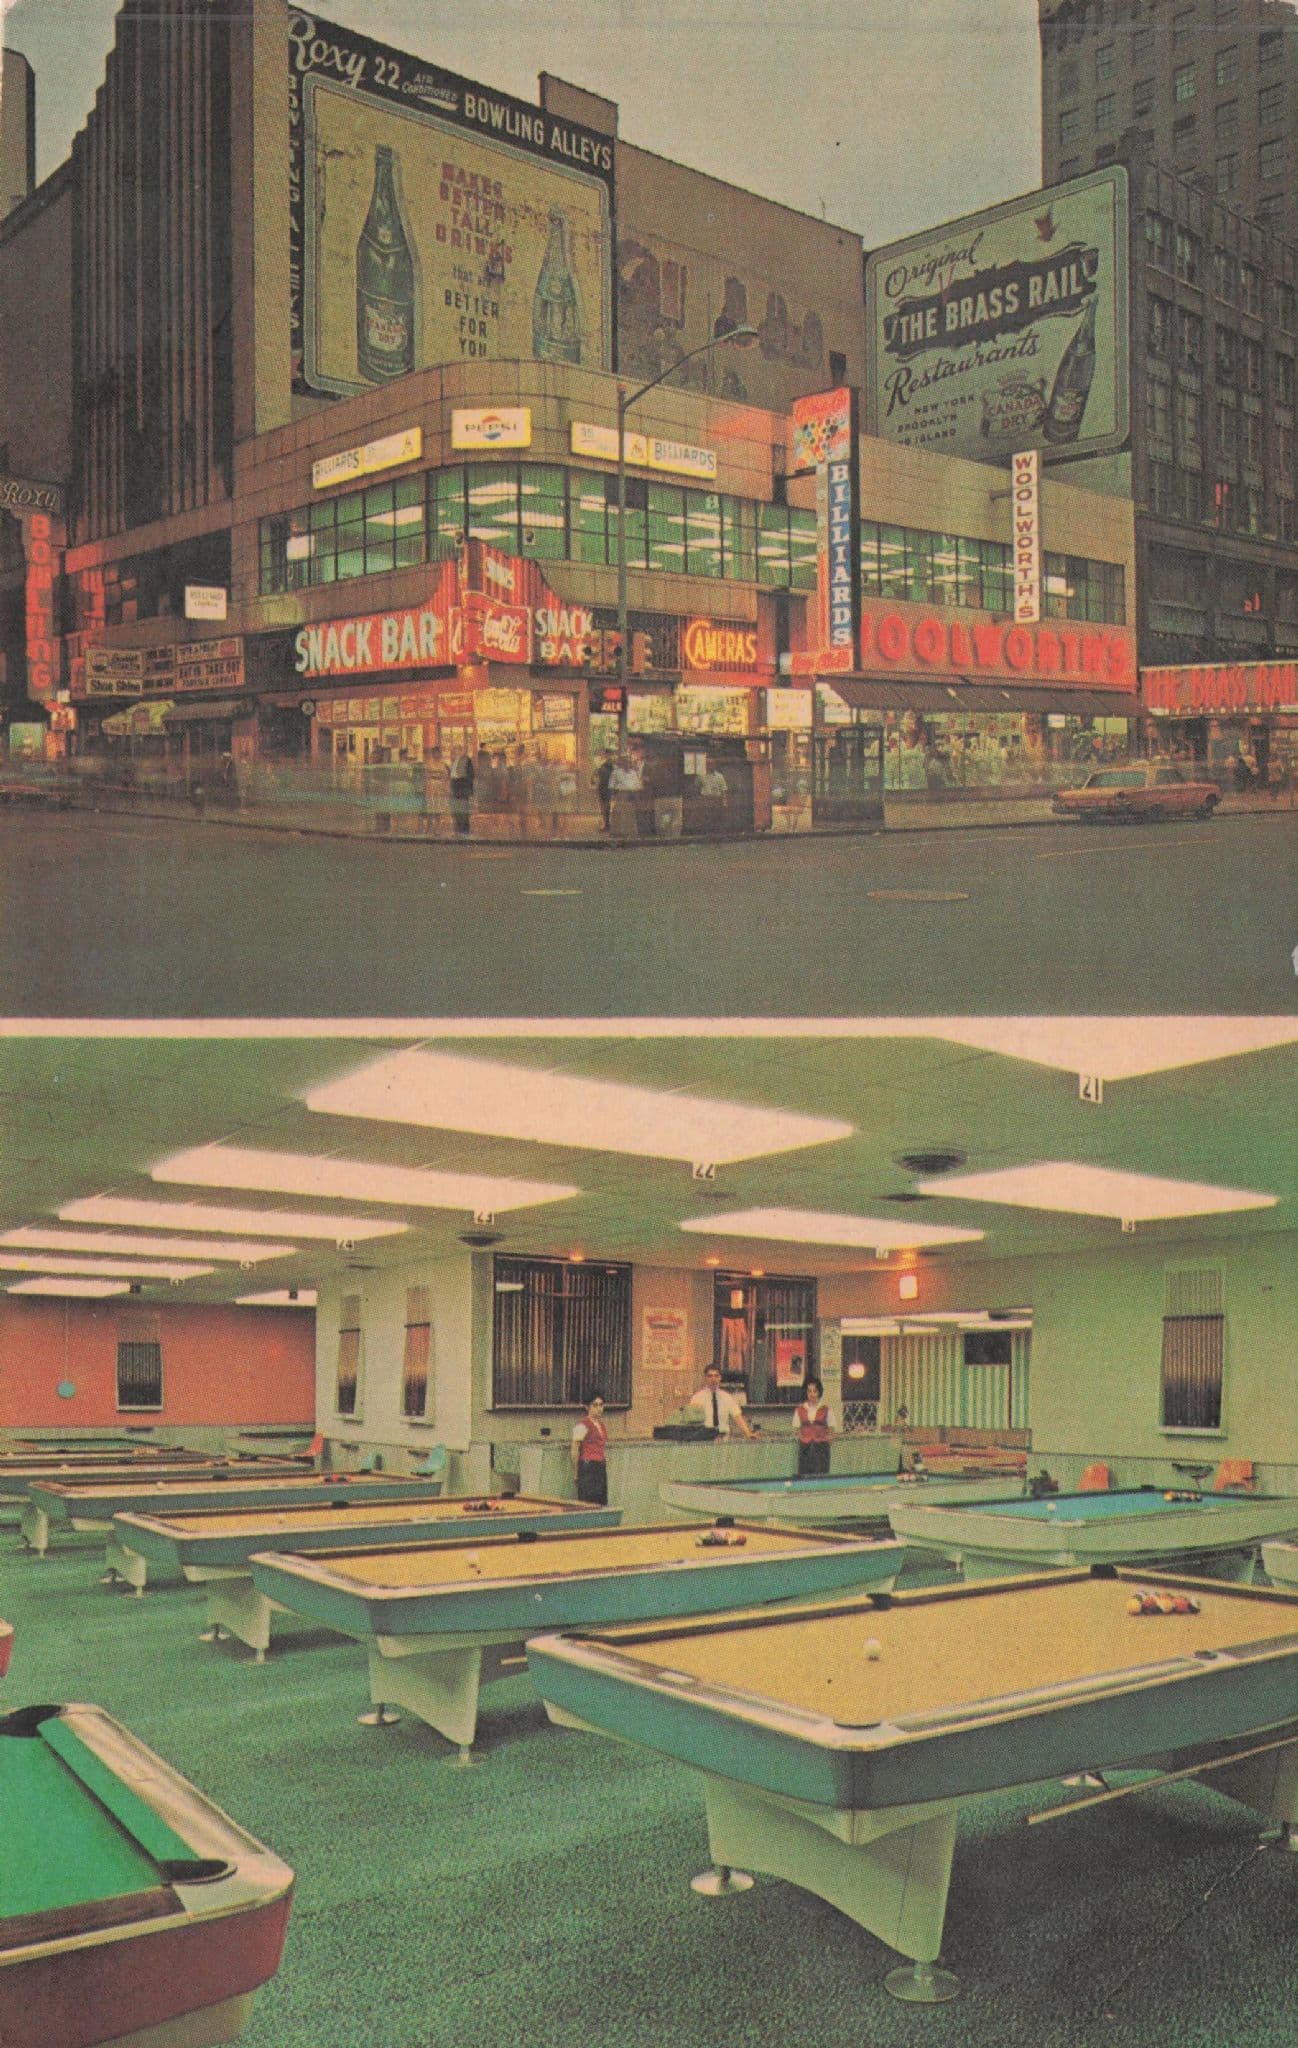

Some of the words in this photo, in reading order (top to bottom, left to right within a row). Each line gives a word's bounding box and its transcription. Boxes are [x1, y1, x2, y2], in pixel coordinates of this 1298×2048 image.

[288, 10, 367, 89] Roxy
[374, 56, 401, 90] 22
[465, 93, 545, 145] BOWLING
[551, 129, 612, 171] ALLEYS
[885, 231, 984, 298] Original
[444, 289, 499, 320] BETTER
[901, 308, 938, 344] THE
[945, 282, 1021, 333] BRASS
[1028, 263, 1083, 306] RAIL
[458, 336, 487, 358] YOU
[460, 315, 488, 339] FOR
[883, 327, 1041, 417] Restaurants
[464, 423, 518, 433] PEPSI
[914, 402, 940, 415] NEW
[654, 441, 716, 472] BILLIARDS
[830, 464, 850, 646] BILLIARDS
[294, 623, 371, 673] SNACK
[380, 610, 440, 664] BAR
[534, 607, 593, 639] SNACK
[685, 619, 757, 669] CAMERAS
[1083, 1075, 1100, 1101] 21
